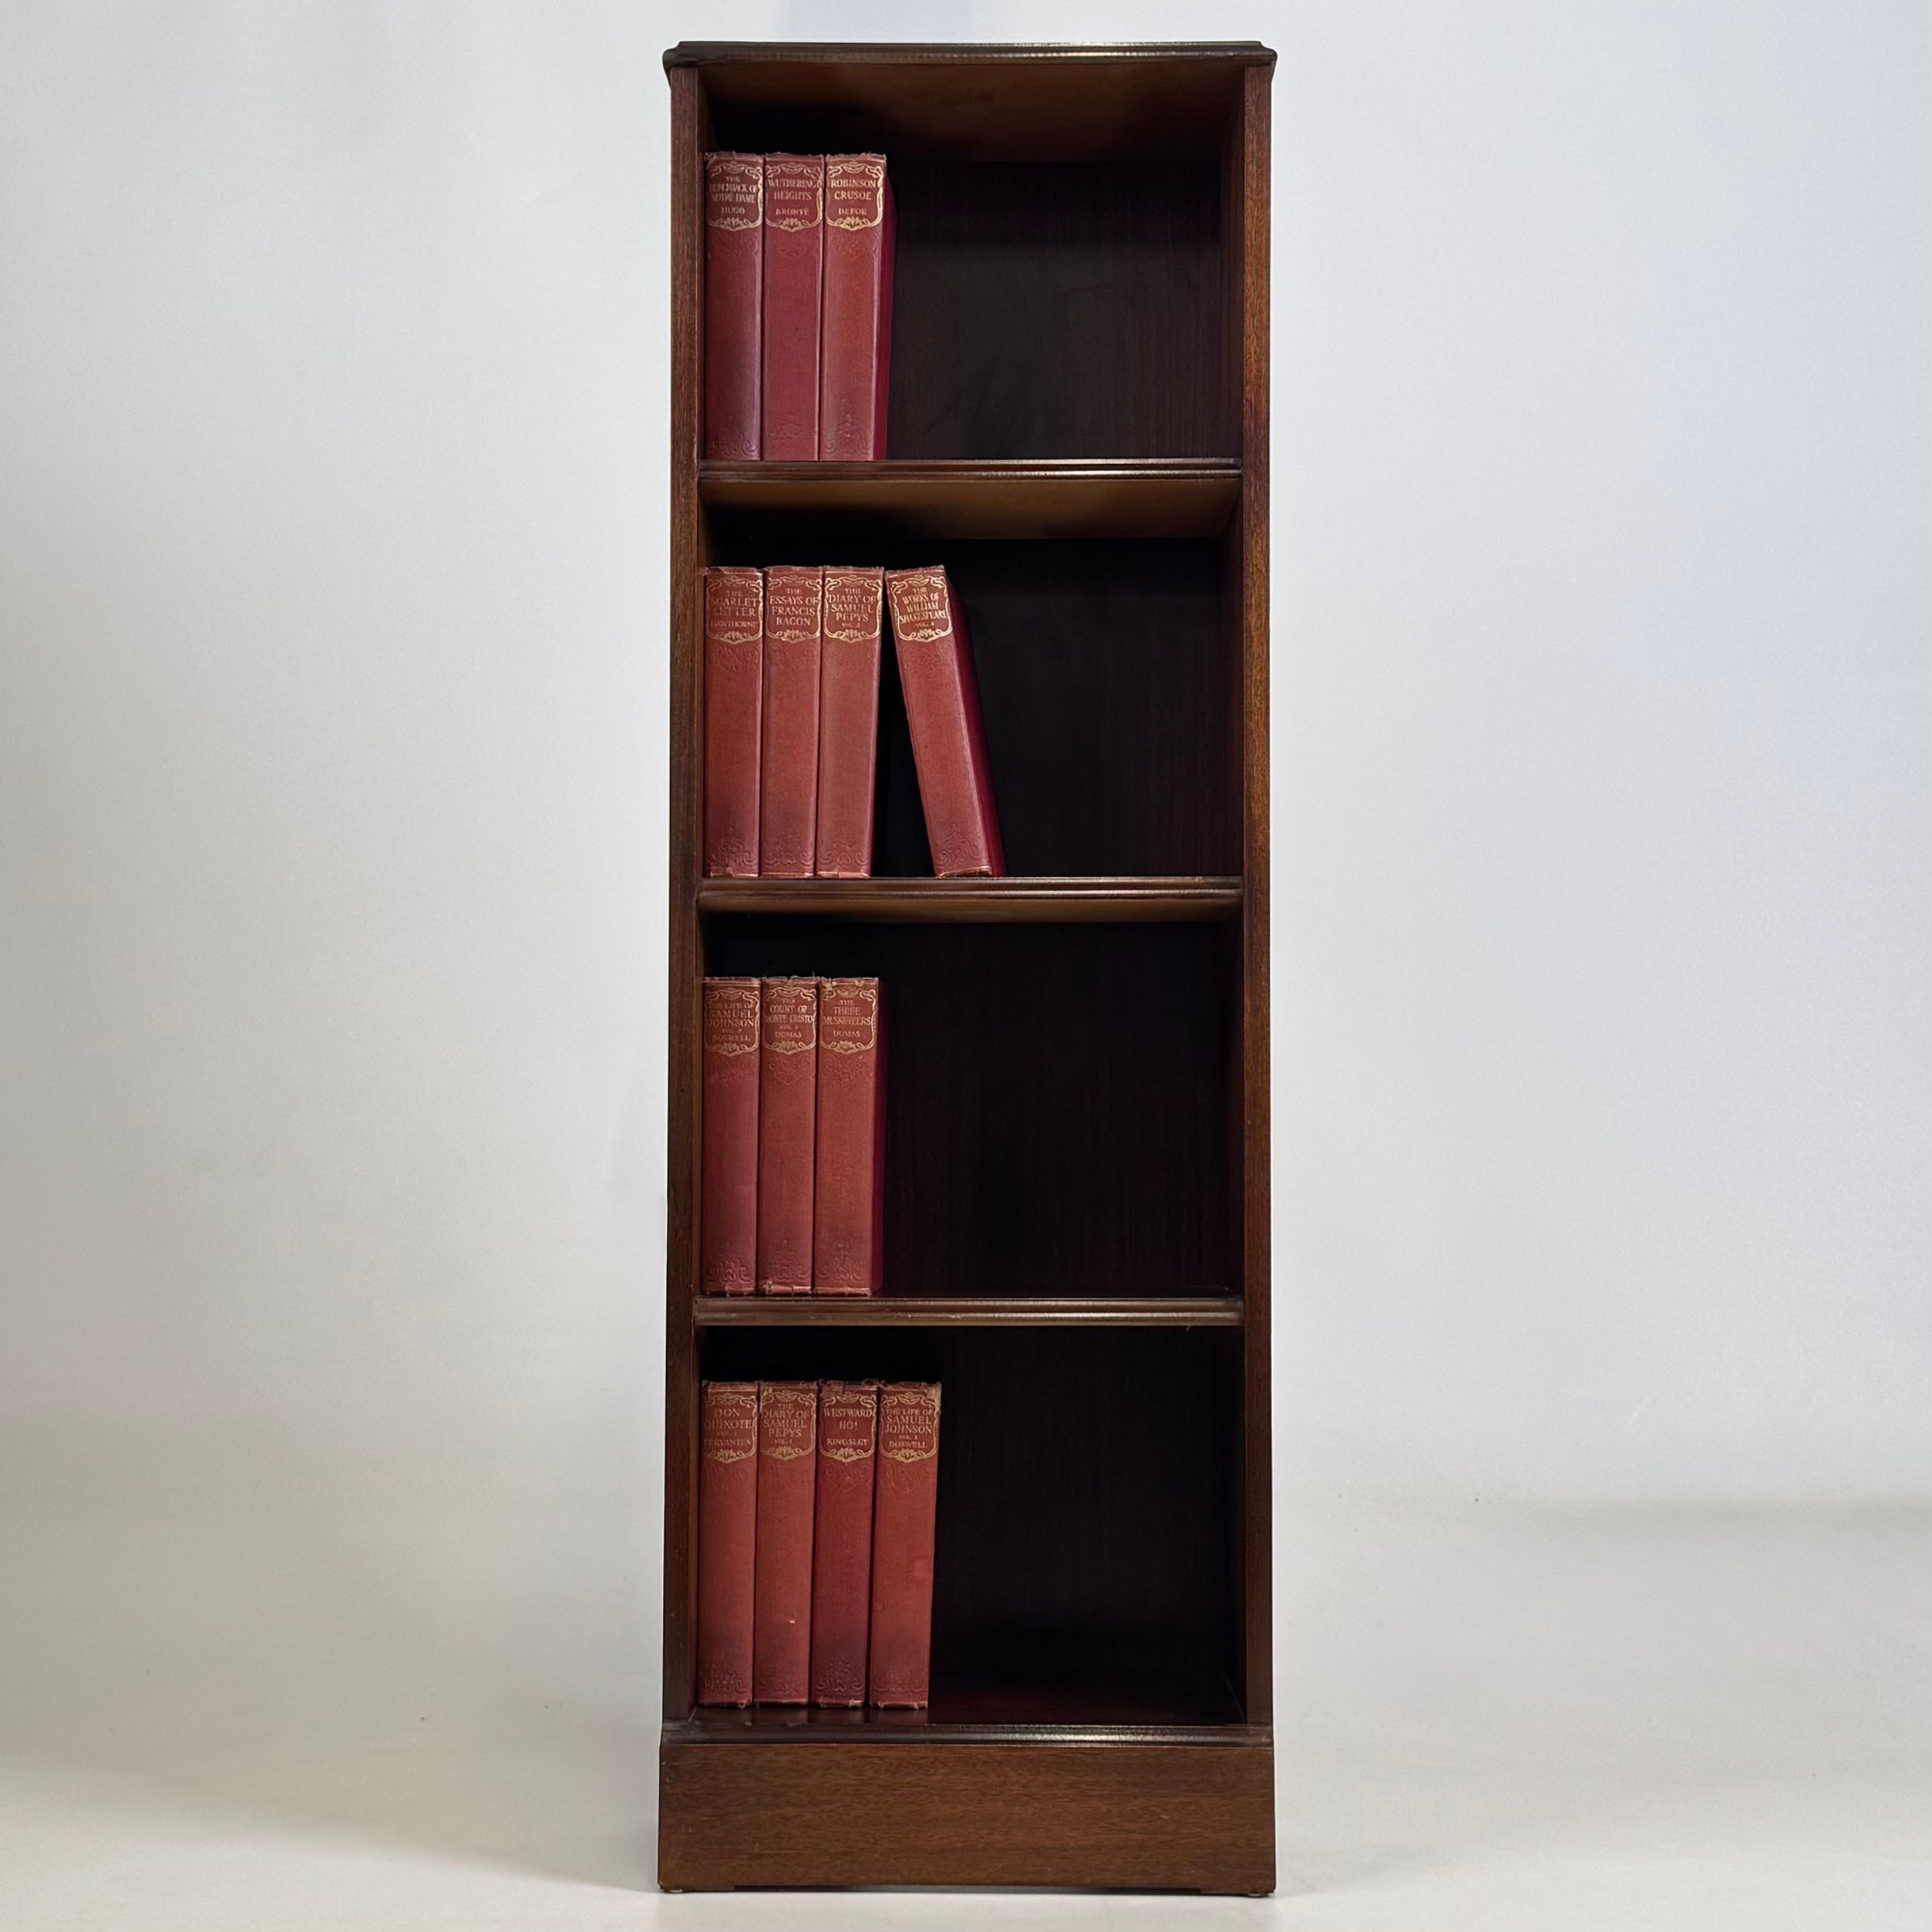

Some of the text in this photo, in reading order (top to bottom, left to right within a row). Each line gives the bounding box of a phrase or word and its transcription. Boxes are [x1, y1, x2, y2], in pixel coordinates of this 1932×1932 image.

[830, 179, 877, 189] ROBINSON
[773, 190, 812, 200] HEIGHTS
[834, 190, 872, 200] CRUSOE
[838, 207, 867, 216] DEFOE
[710, 597, 759, 608] SCARLET
[769, 596, 820, 606] ESSAYS OF
[829, 594, 877, 604] DIARY OF
[901, 592, 940, 605] WORKS OF
[714, 607, 756, 617] LETTER
[771, 606, 815, 616] FRANCIS
[831, 604, 874, 614] SAMUEL
[906, 601, 940, 613] WILLIAM
[776, 617, 811, 626] BACON
[836, 612, 869, 622] PEPYS
[899, 610, 947, 624] SHAKESPEARE
[709, 1009, 753, 1018] SAMUEL
[769, 1005, 808, 1014] COUNT OF
[833, 1006, 862, 1015] THREE
[708, 1018, 755, 1028] JOHNSON
[823, 1016, 872, 1026] MUSKETEERS
[715, 1408, 740, 1418] DON
[762, 1410, 810, 1419] DIARY OF
[823, 1408, 873, 1418] WESTWARD
[704, 1419, 752, 1431] QUIXOTE
[763, 1419, 808, 1429] SAMUEL
[887, 1415, 932, 1425] SAMUEL
[839, 1420, 858, 1431] HO!
[884, 1424, 933, 1434] JOHNSON
[768, 1428, 803, 1438] PEPYS
[826, 1438, 869, 1446] KINGSLEY
[888, 1440, 927, 1449] BOSWELL
